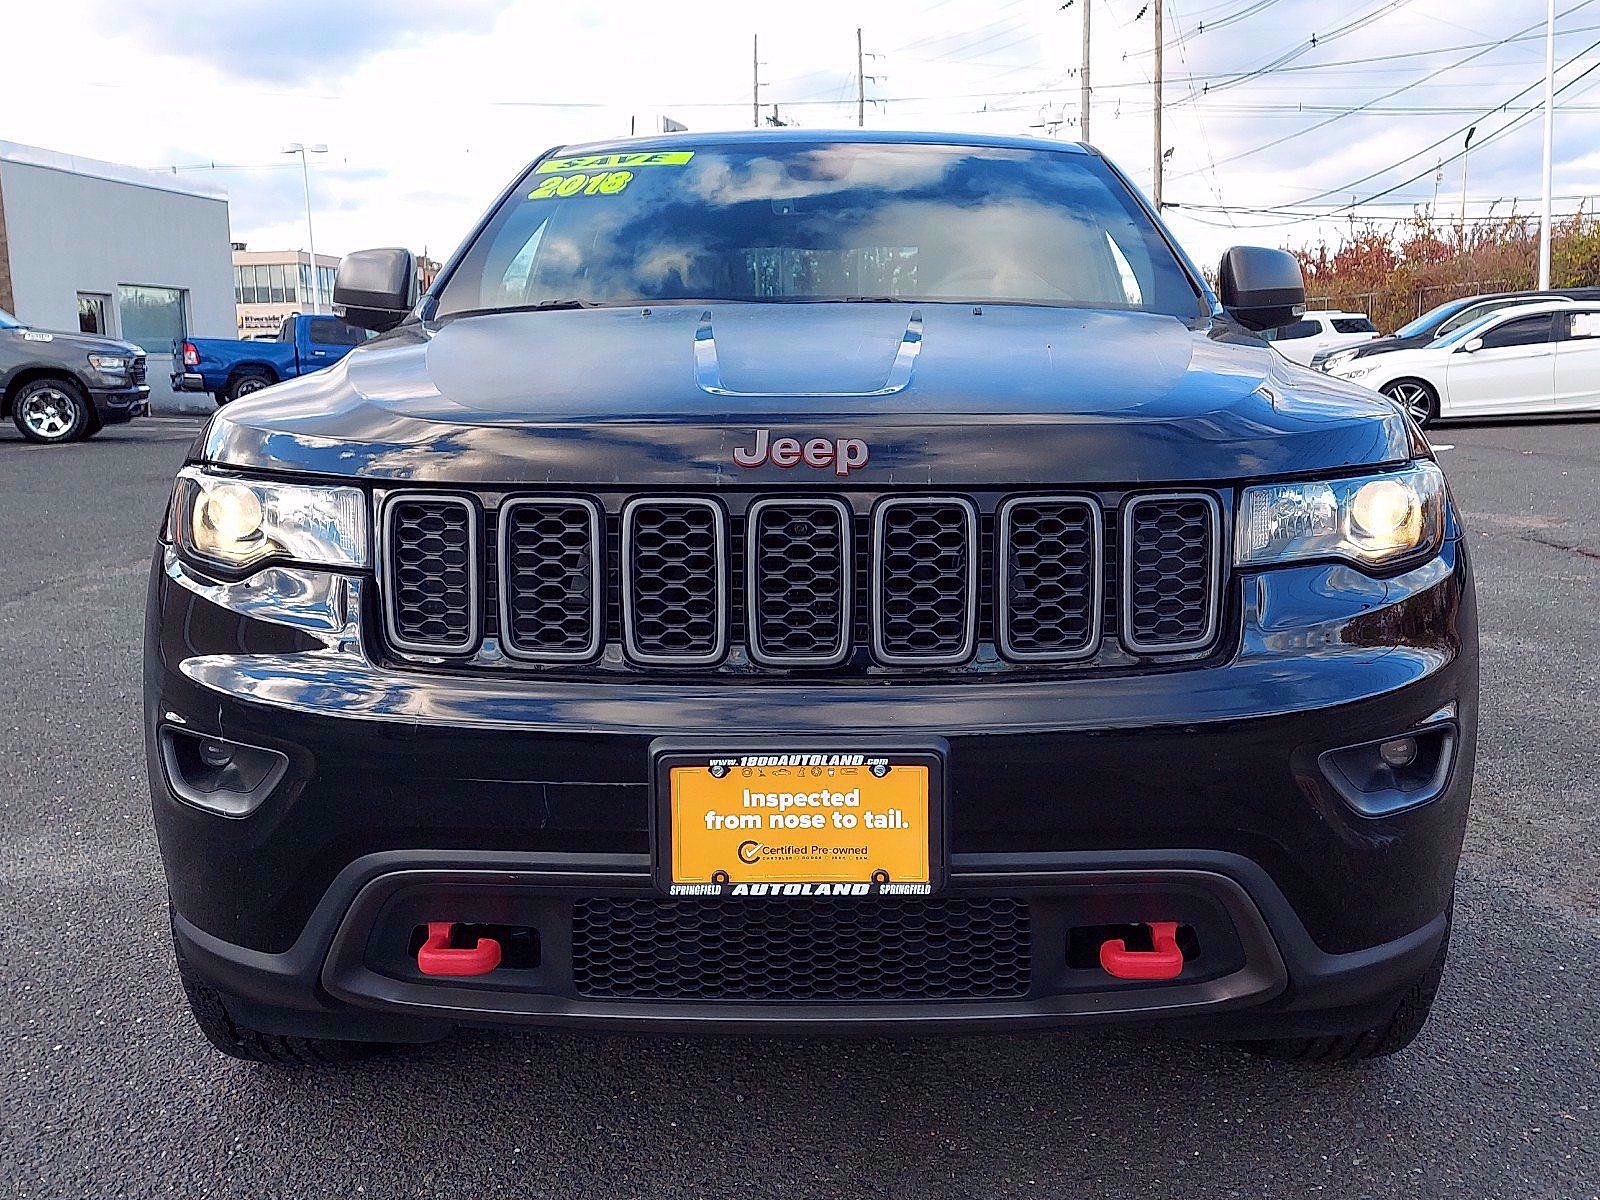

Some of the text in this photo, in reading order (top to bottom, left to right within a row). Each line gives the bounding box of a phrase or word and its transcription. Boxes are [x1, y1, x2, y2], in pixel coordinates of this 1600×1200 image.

[556, 153, 670, 169] SAVE
[528, 171, 634, 200] 2018
[733, 429, 870, 476] Jeep
[709, 754, 889, 767] www.1800AUTOLAND.com
[743, 788, 860, 811] Inspected
[704, 808, 910, 829] from nose to tail.
[762, 845, 868, 855] Certified Pre-owned
[669, 883, 931, 896] SPRINGFIELD AUTOLAND SPRINGFIELD
